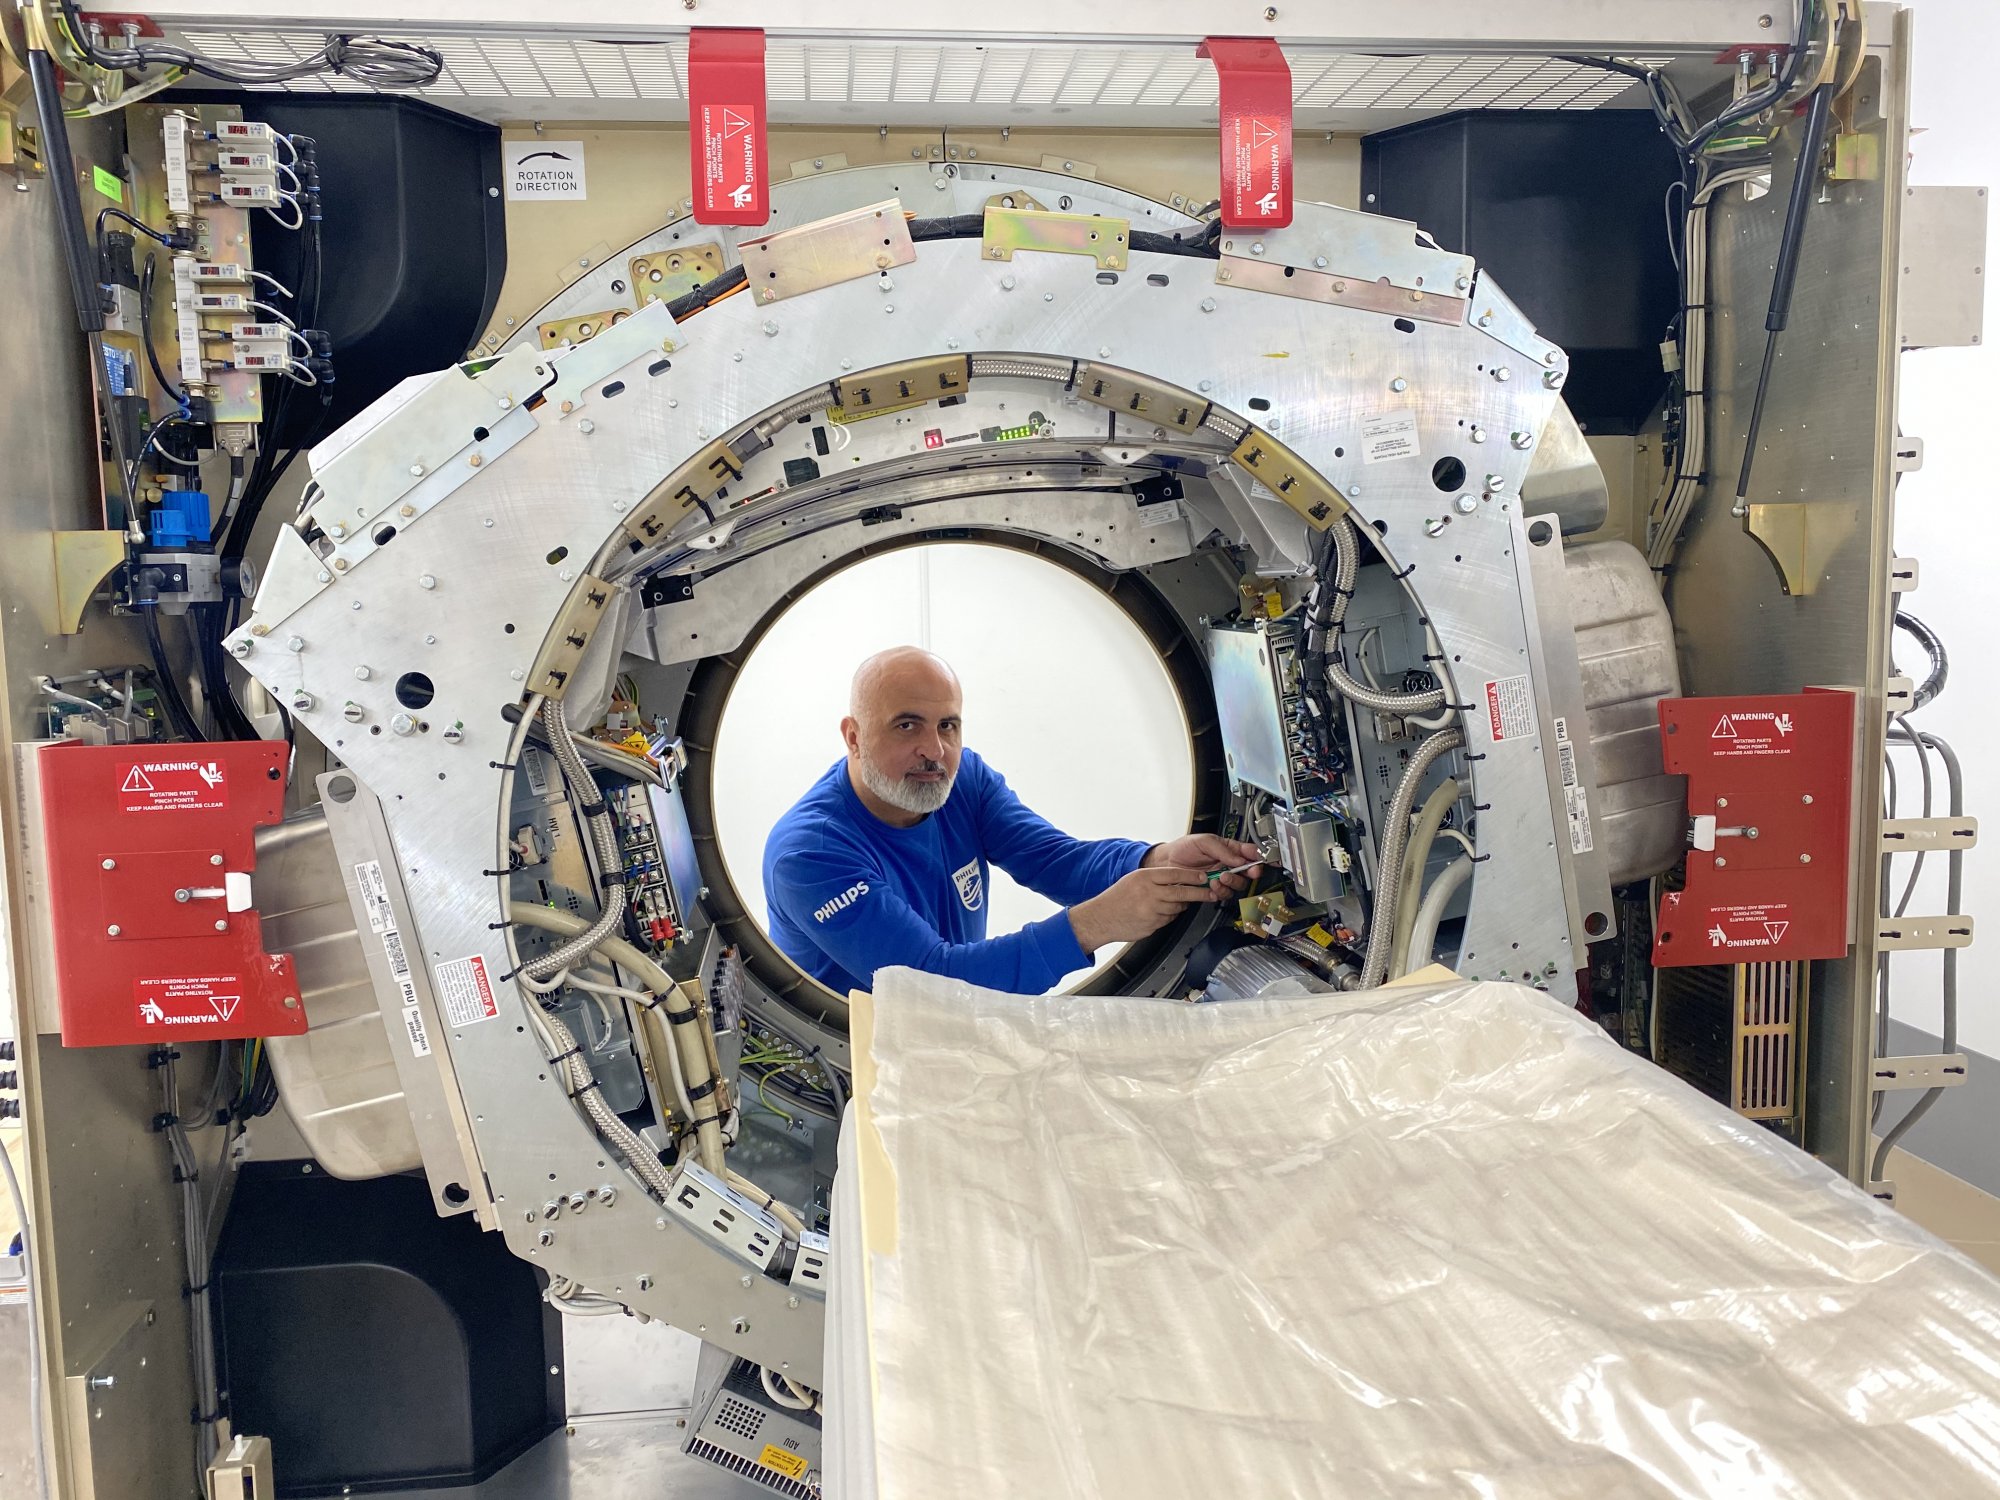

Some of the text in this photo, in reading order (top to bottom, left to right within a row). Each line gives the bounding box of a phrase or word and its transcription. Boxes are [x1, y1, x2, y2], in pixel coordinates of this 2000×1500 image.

[744, 134, 753, 182] WARNING
[518, 172, 573, 180] ROTATION
[516, 182, 577, 191] DIRECTION
[1490, 695, 1500, 727] DANGER
[1555, 720, 1565, 739] PBB
[144, 762, 198, 772] WARNING
[956, 863, 978, 882] PHILIP
[814, 881, 869, 923] PHILIPS
[1727, 939, 1769, 947] WARNING
[403, 983, 415, 1003] PBU
[474, 969, 490, 1003] DANGER
[164, 1015, 218, 1024] WARNING
[407, 1021, 419, 1043] passed
[411, 1010, 428, 1051] Quality check
[783, 1438, 800, 1450] ADU
